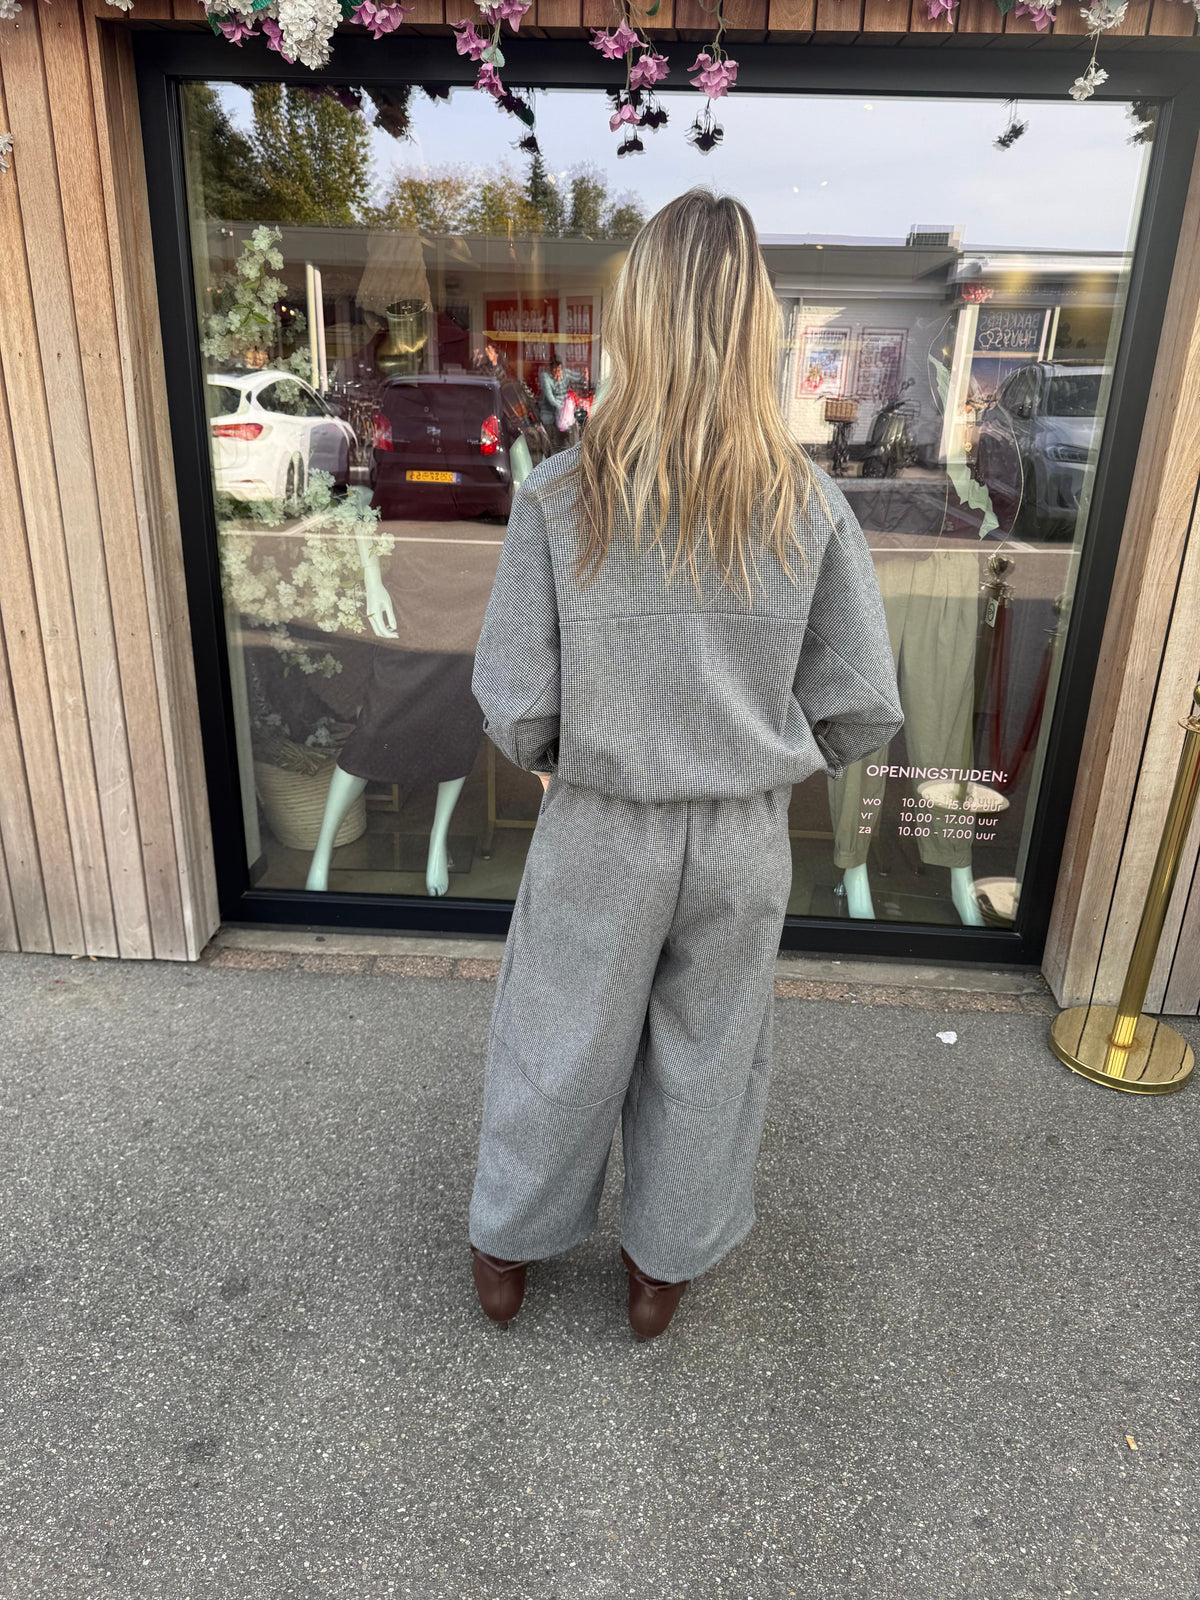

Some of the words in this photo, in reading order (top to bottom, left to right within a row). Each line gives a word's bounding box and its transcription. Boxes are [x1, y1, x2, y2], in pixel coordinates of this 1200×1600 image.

[866, 764, 1008, 783] OPENINGSTIJDEN:
[862, 797, 881, 806] wo
[902, 797, 935, 809] 10.00
[982, 801, 1003, 812] uur
[860, 812, 873, 820] vr
[900, 812, 933, 823] 10.00
[944, 814, 975, 825] 17.00
[978, 817, 999, 826] uur
[858, 825, 872, 834] za
[897, 826, 930, 837] 10.00
[942, 828, 972, 839] 17.00
[975, 831, 997, 841] uur
